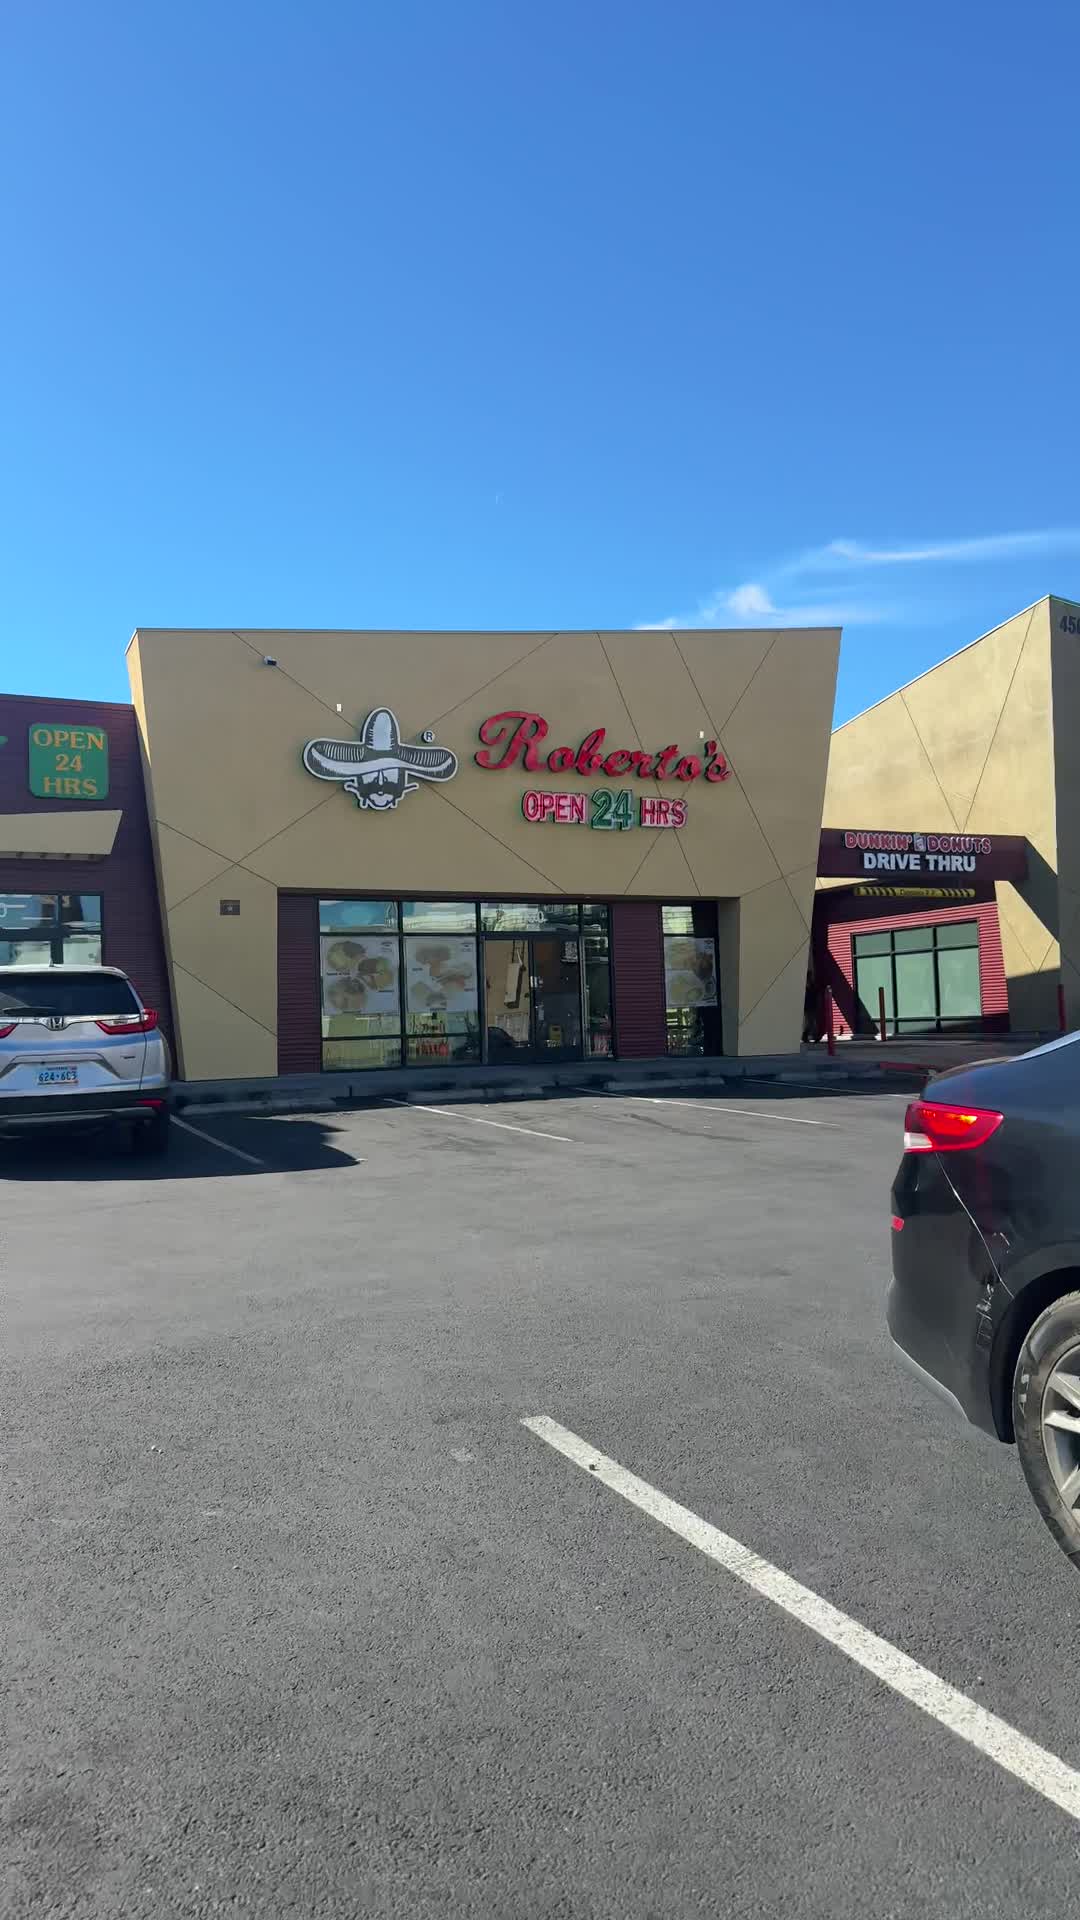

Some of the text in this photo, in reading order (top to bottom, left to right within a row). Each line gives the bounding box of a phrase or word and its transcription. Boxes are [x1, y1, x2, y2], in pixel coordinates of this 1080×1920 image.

[33, 729, 105, 750] OPEN
[474, 711, 732, 783] Roberto's
[55, 754, 82, 772] 24
[43, 777, 98, 796] HRS
[523, 788, 688, 830] OPEN 24 HRS
[845, 832, 992, 854] DUNKIN' DONUTS
[863, 852, 976, 872] DRIVE THRU
